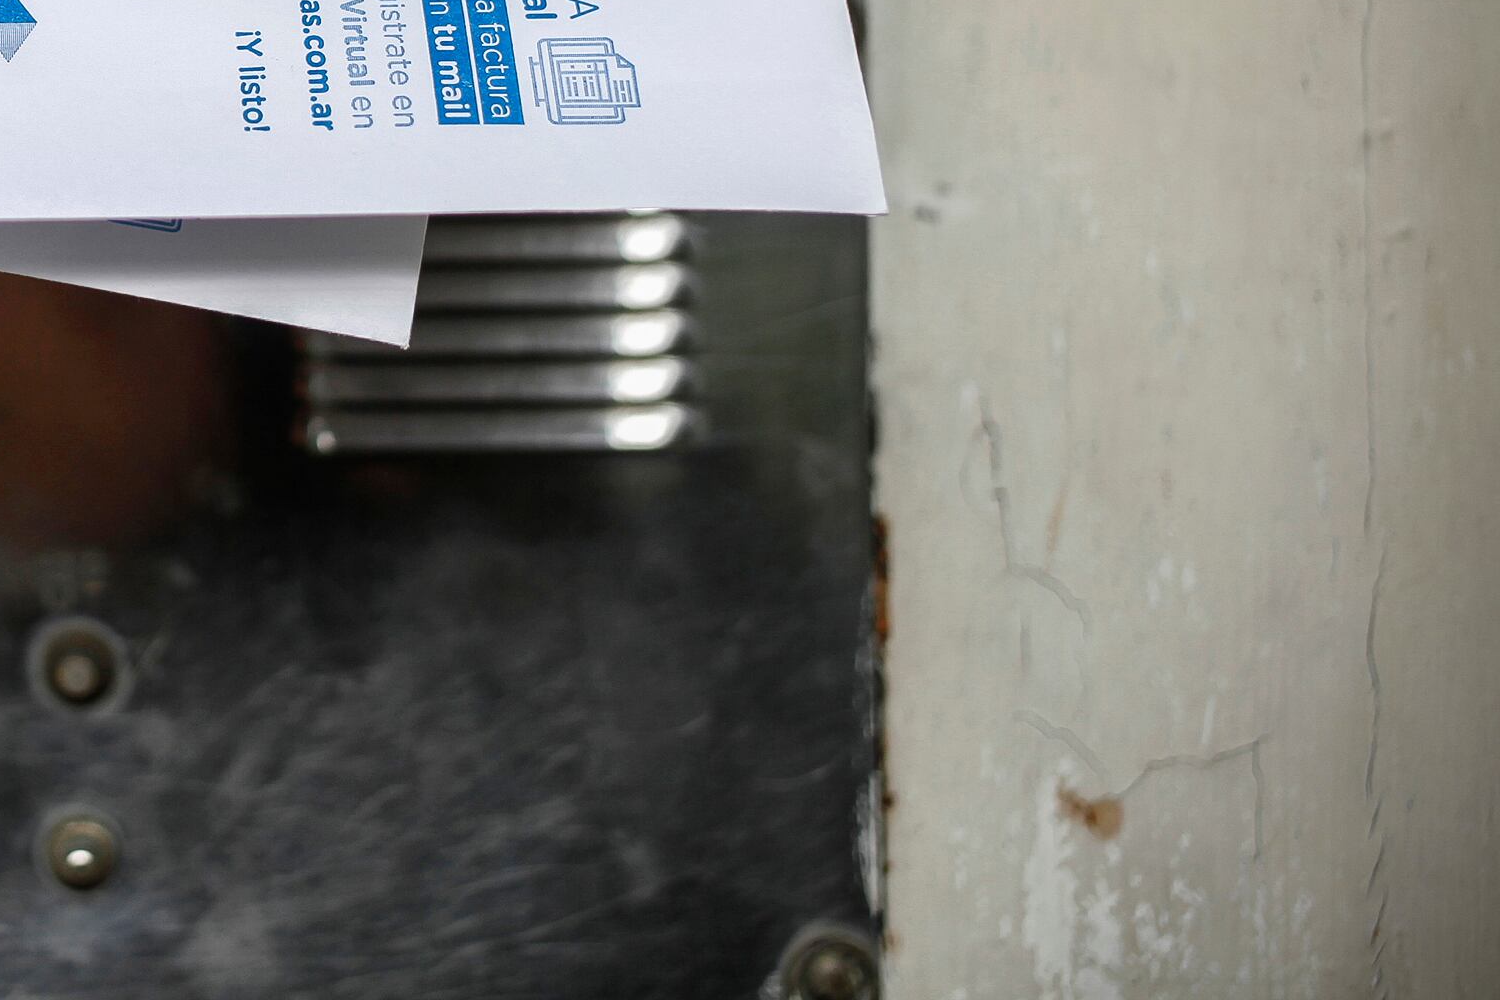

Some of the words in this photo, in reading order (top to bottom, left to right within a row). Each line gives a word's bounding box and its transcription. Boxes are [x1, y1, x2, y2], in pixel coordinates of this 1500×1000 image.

[432, 23, 458, 52] tu
[437, 62, 472, 120] mail
[478, 21, 512, 120] factura
[239, 65, 271, 132] listo!
[350, 96, 375, 129] en
[388, 96, 415, 128] en
